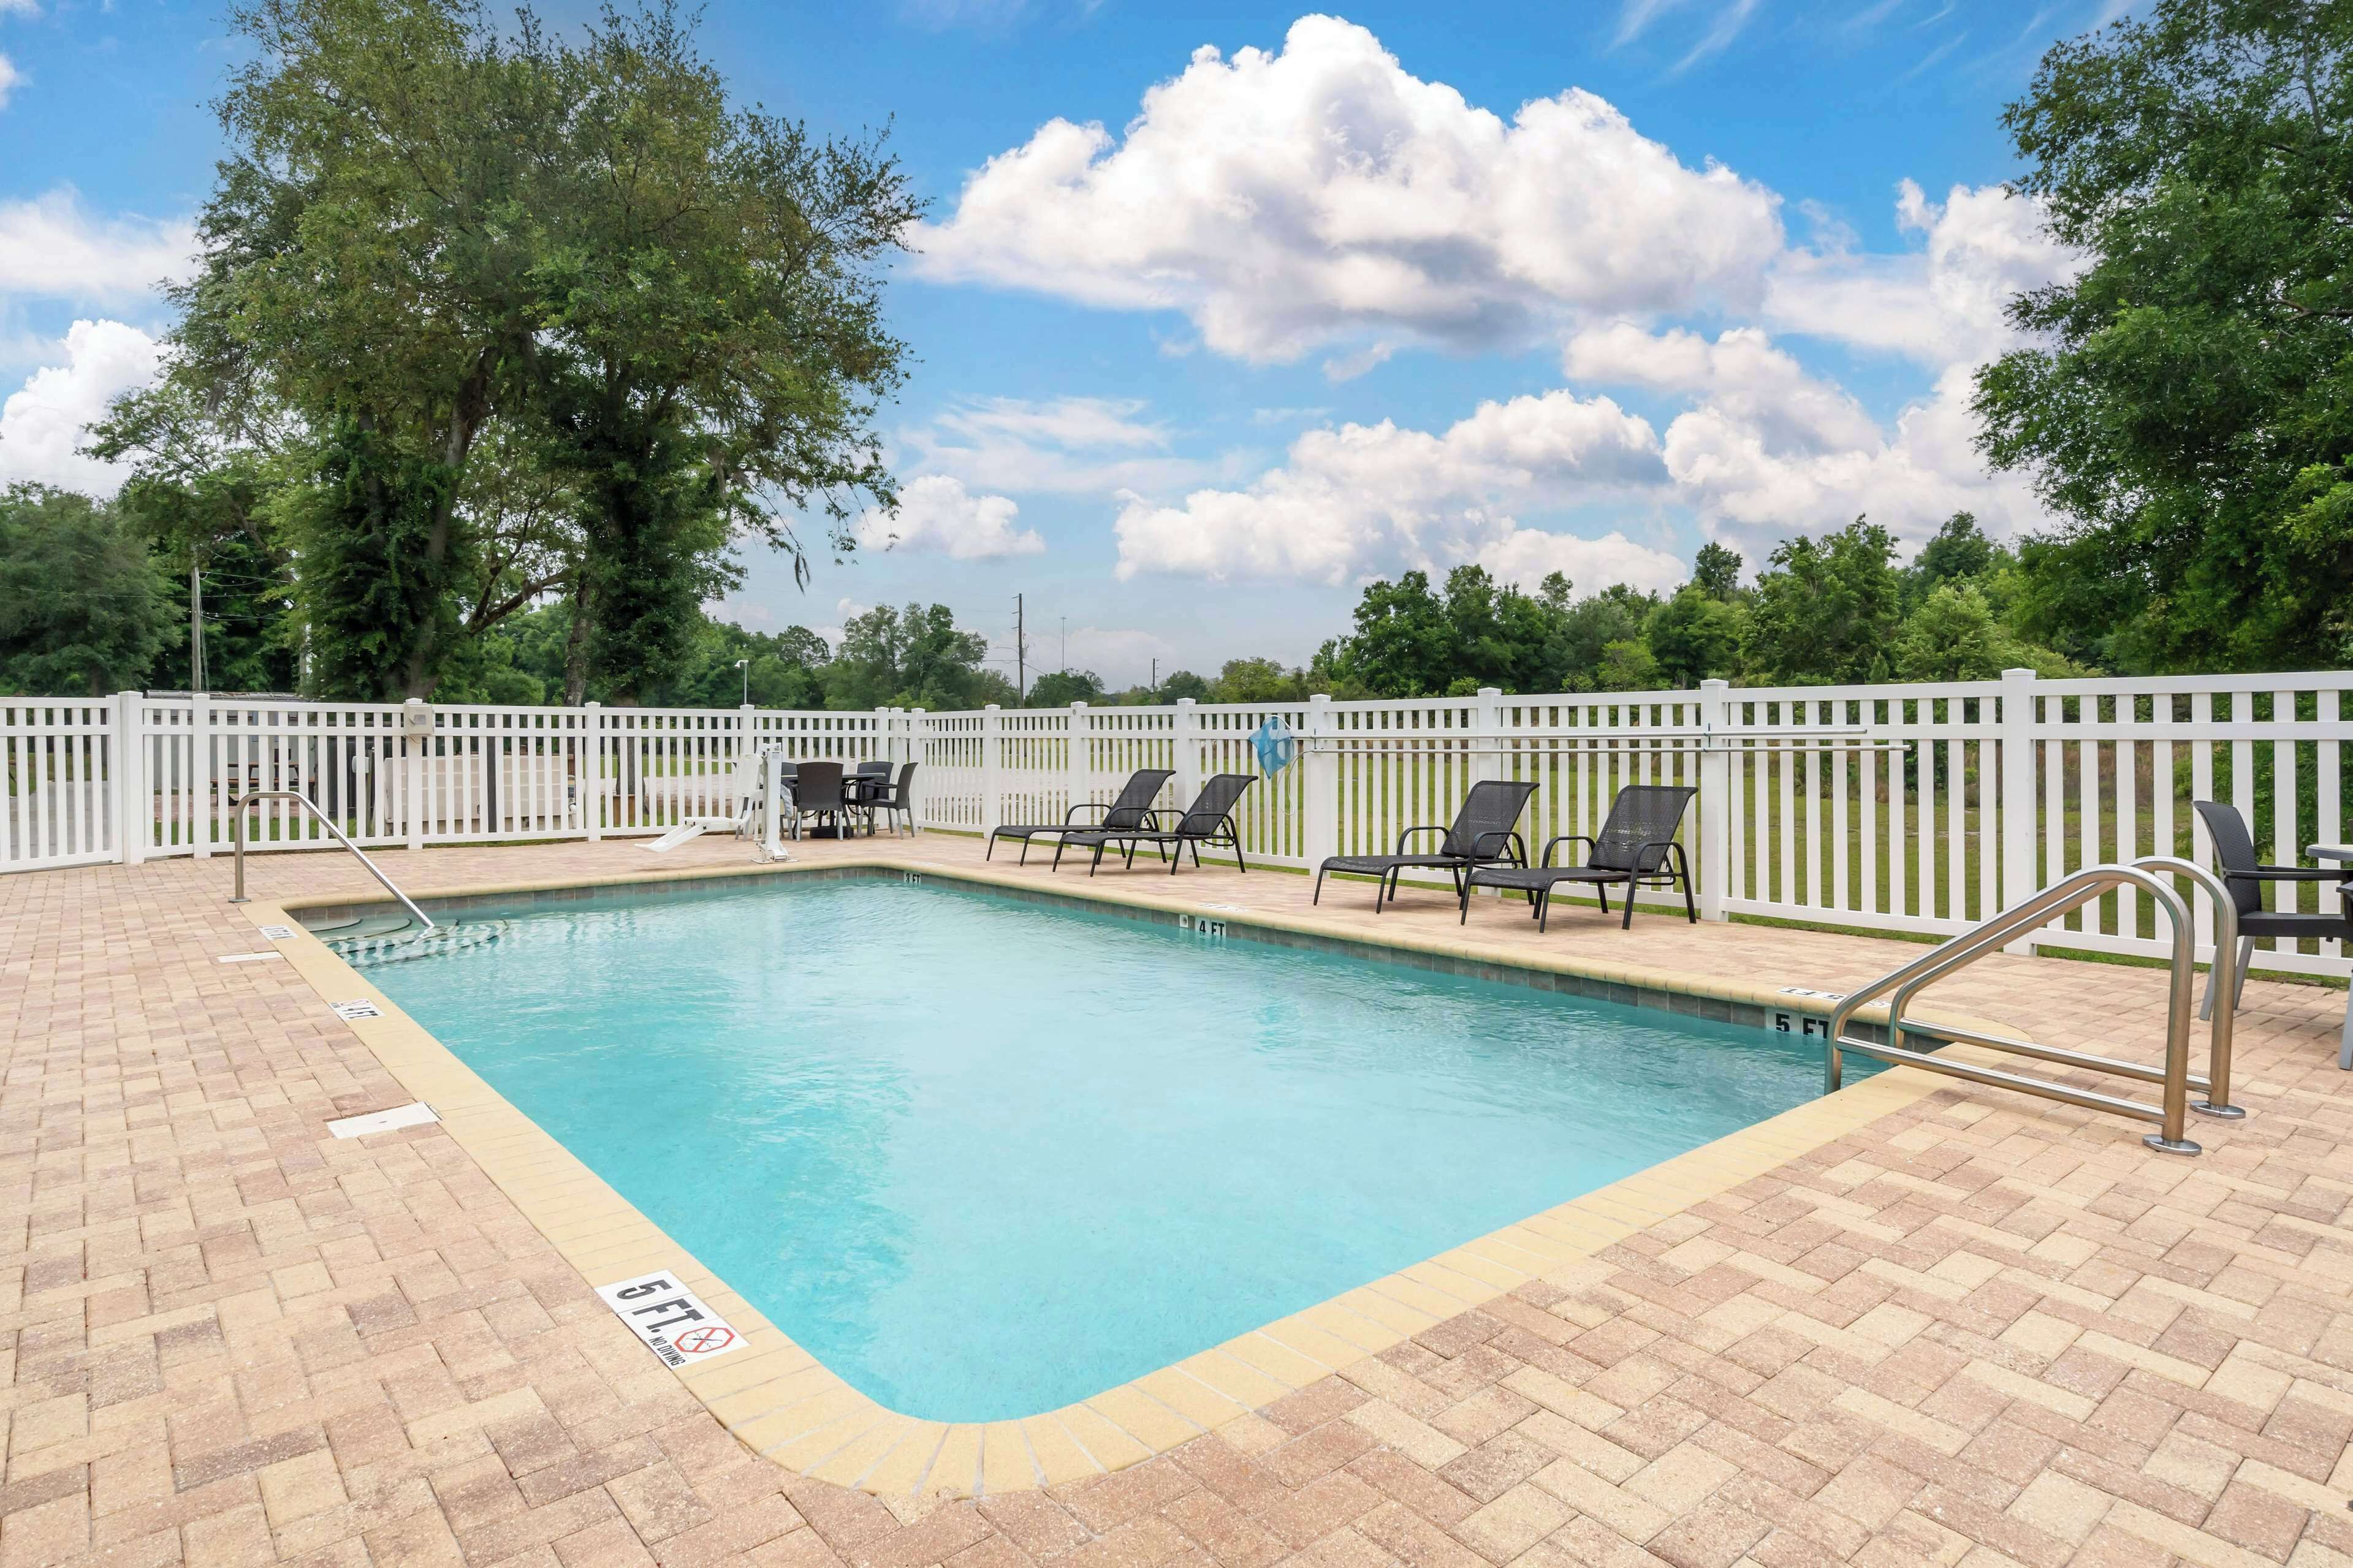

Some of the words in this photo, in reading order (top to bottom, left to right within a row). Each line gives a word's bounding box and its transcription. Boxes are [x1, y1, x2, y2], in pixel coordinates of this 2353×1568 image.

[906, 873, 910, 883] 3
[913, 874, 920, 884] FT
[1199, 920, 1206, 933] 4
[1211, 922, 1225, 936] FT
[1776, 1013, 1790, 1032] 5
[617, 1279, 672, 1300] 5
[631, 1298, 705, 1333] FT.
[648, 1336, 667, 1346] NO
[656, 1345, 686, 1366] DIVING
